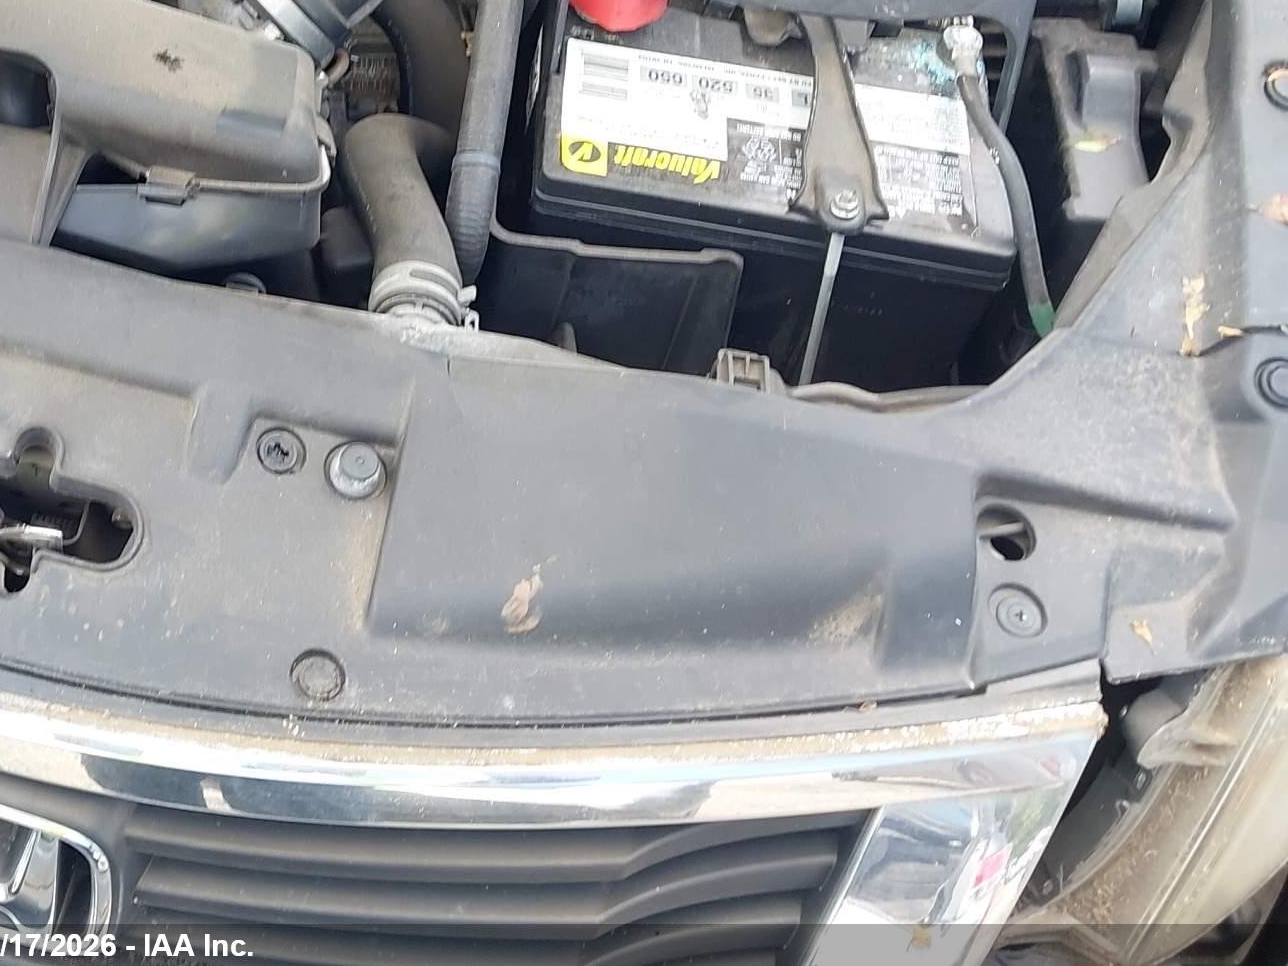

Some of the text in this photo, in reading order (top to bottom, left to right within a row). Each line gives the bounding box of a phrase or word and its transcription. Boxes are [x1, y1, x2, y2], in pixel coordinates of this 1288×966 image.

[648, 68, 684, 85] 650
[698, 77, 733, 95] 520
[614, 144, 721, 184] Valucraft
